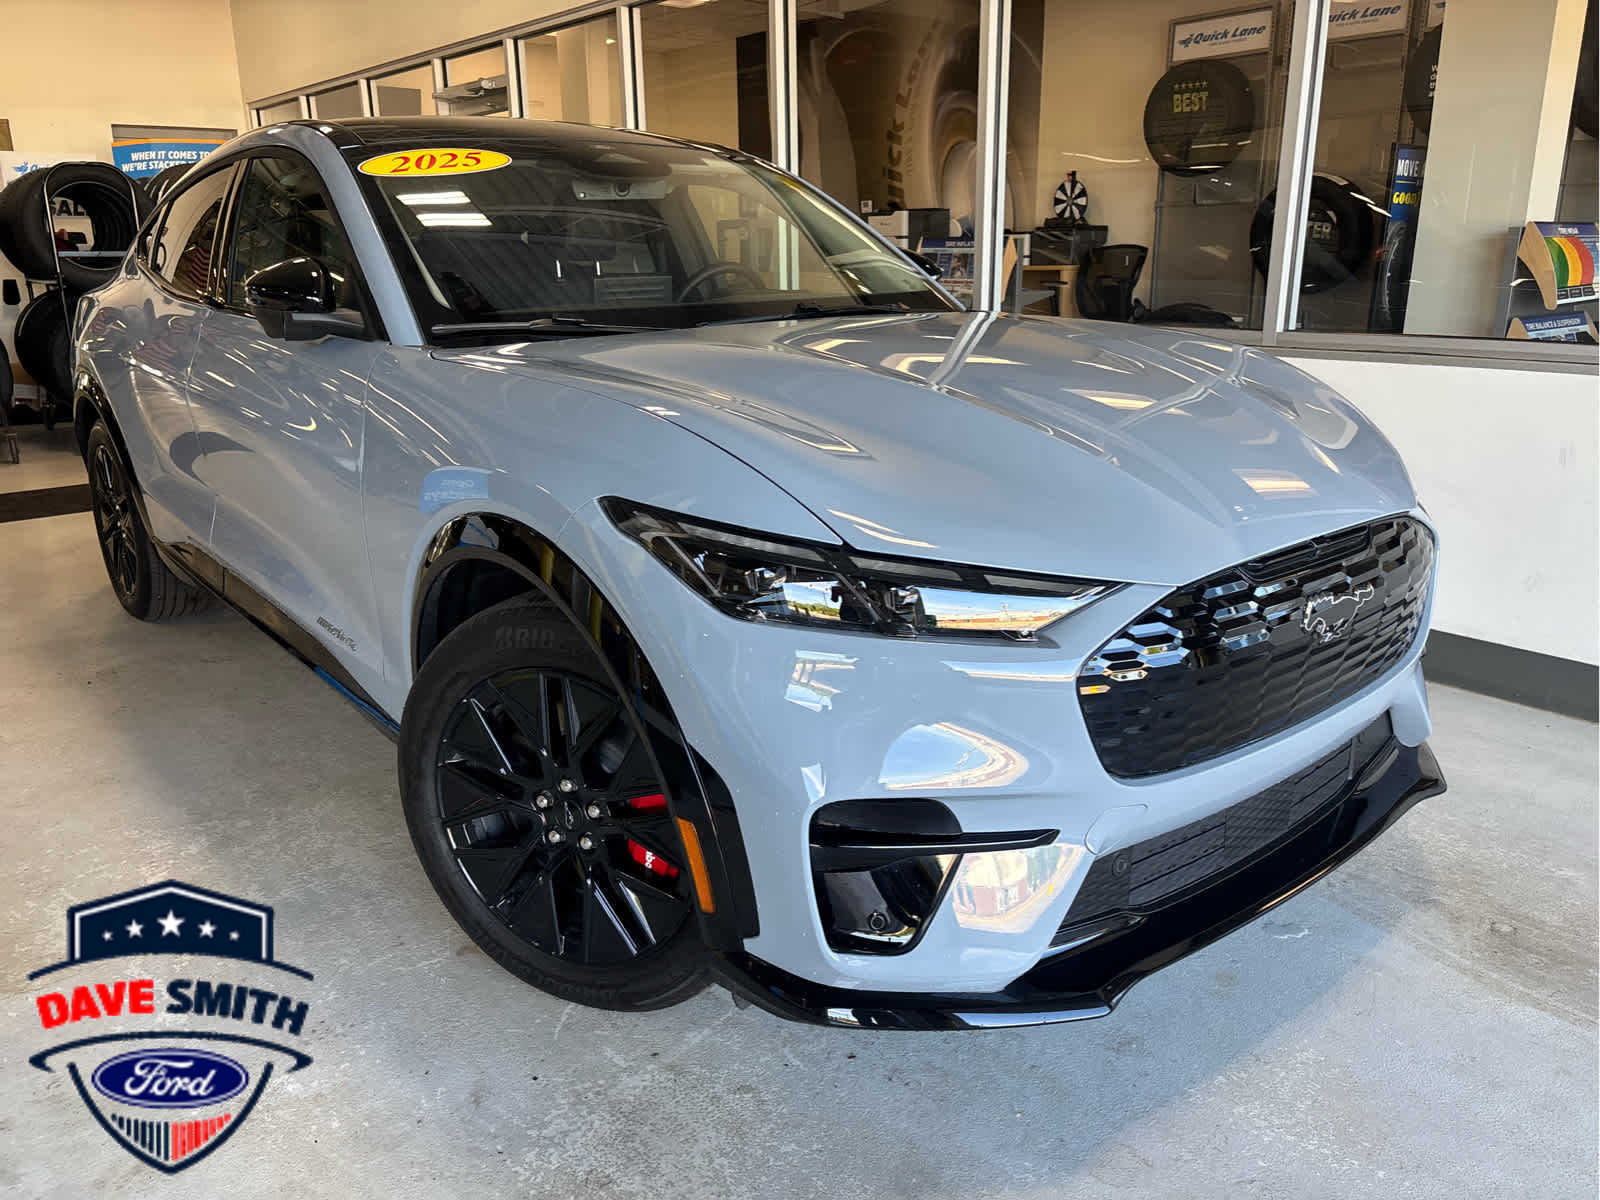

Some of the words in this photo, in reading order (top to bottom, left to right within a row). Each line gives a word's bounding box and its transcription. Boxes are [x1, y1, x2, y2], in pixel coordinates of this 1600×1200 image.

[1327, 8, 1360, 23] uick
[1360, 5, 1401, 19] Lane
[1194, 29, 1230, 45] Quick
[1231, 25, 1266, 38] Lane
[1173, 91, 1208, 113] BEST
[131, 152, 156, 161] WHEN
[157, 151, 166, 160] IT
[167, 151, 197, 160] COMES
[391, 152, 482, 173] 2025
[121, 162, 147, 172] WE'RE
